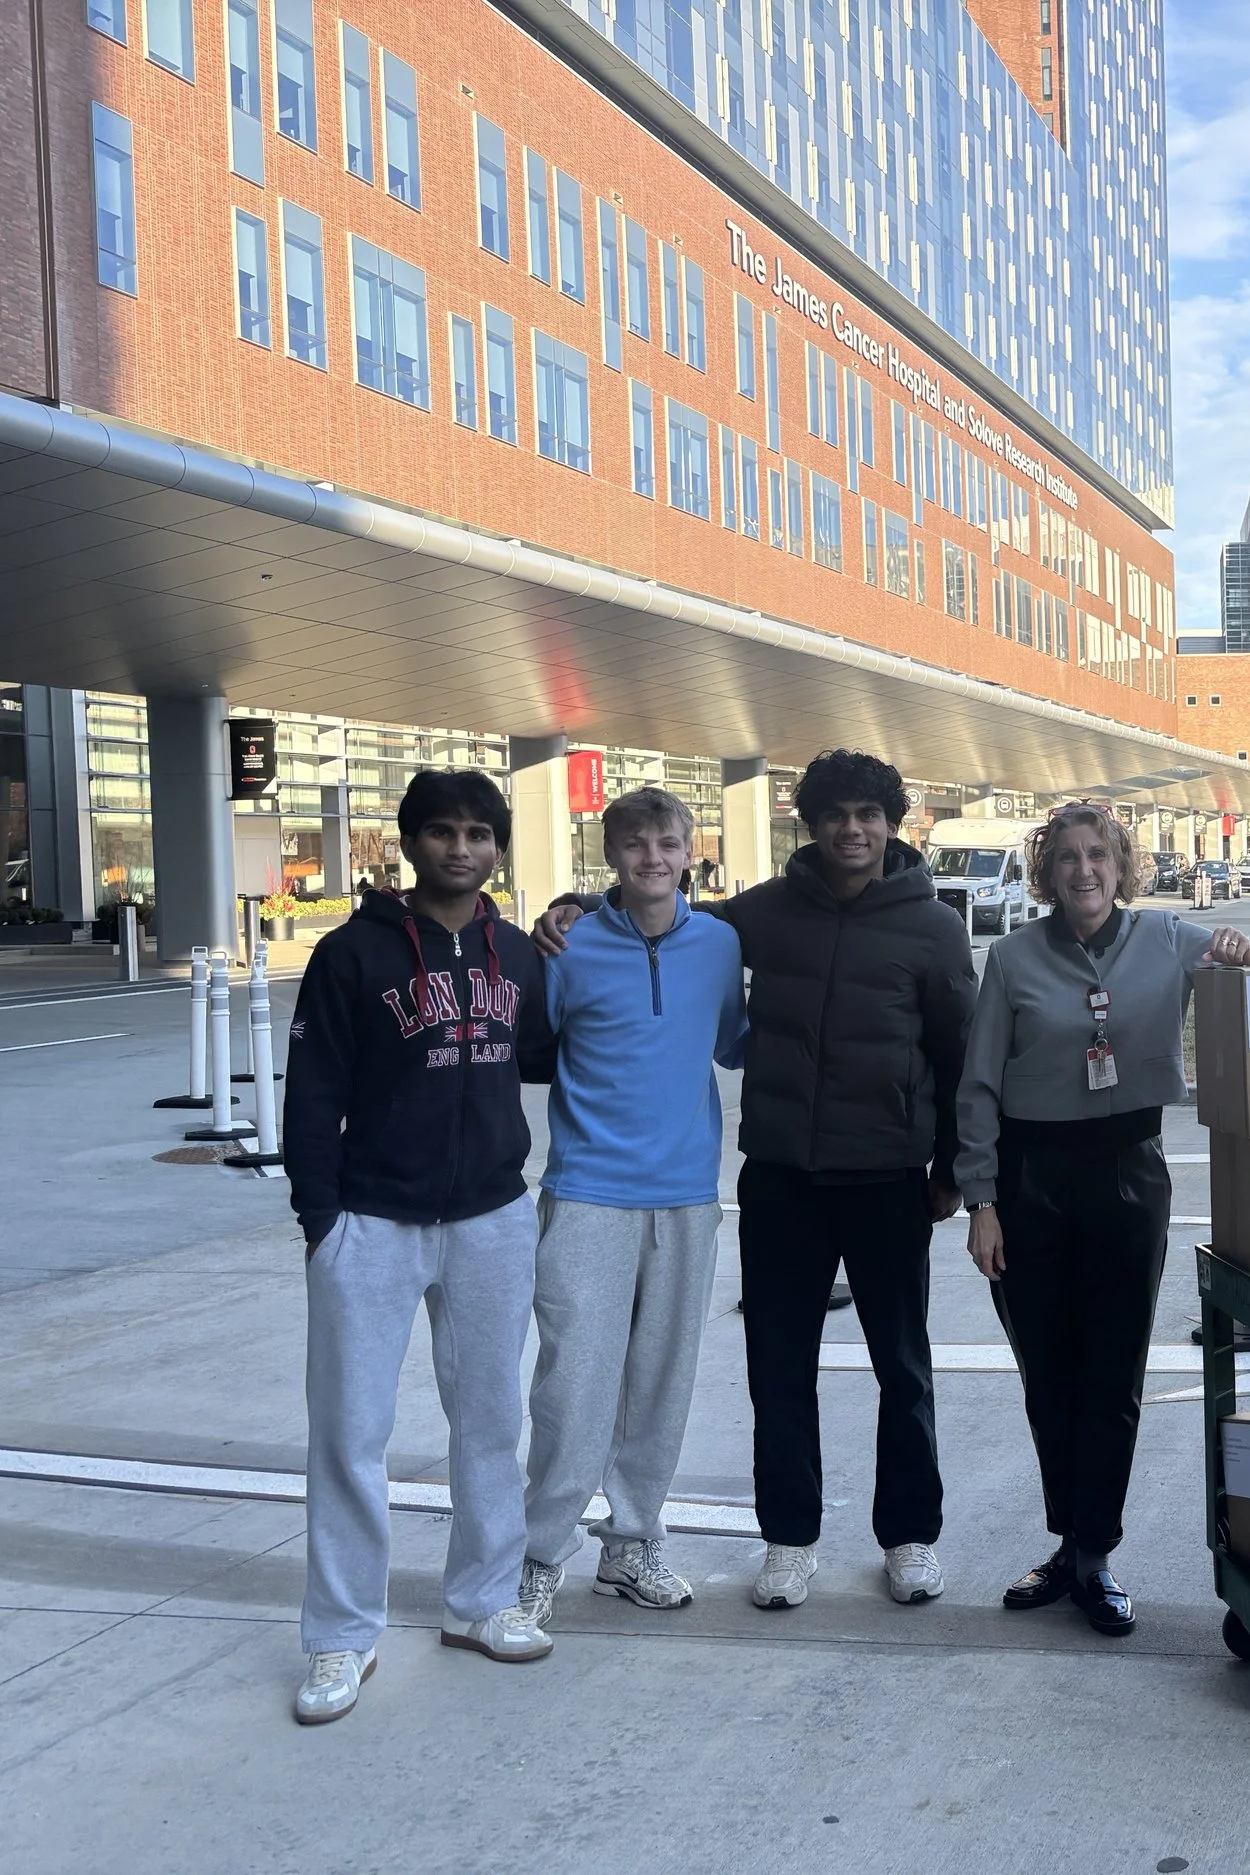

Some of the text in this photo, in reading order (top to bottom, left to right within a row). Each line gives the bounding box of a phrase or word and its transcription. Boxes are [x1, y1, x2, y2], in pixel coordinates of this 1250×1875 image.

[725, 219, 1078, 511] The James Cancer Hospital and Solove Research Institute
